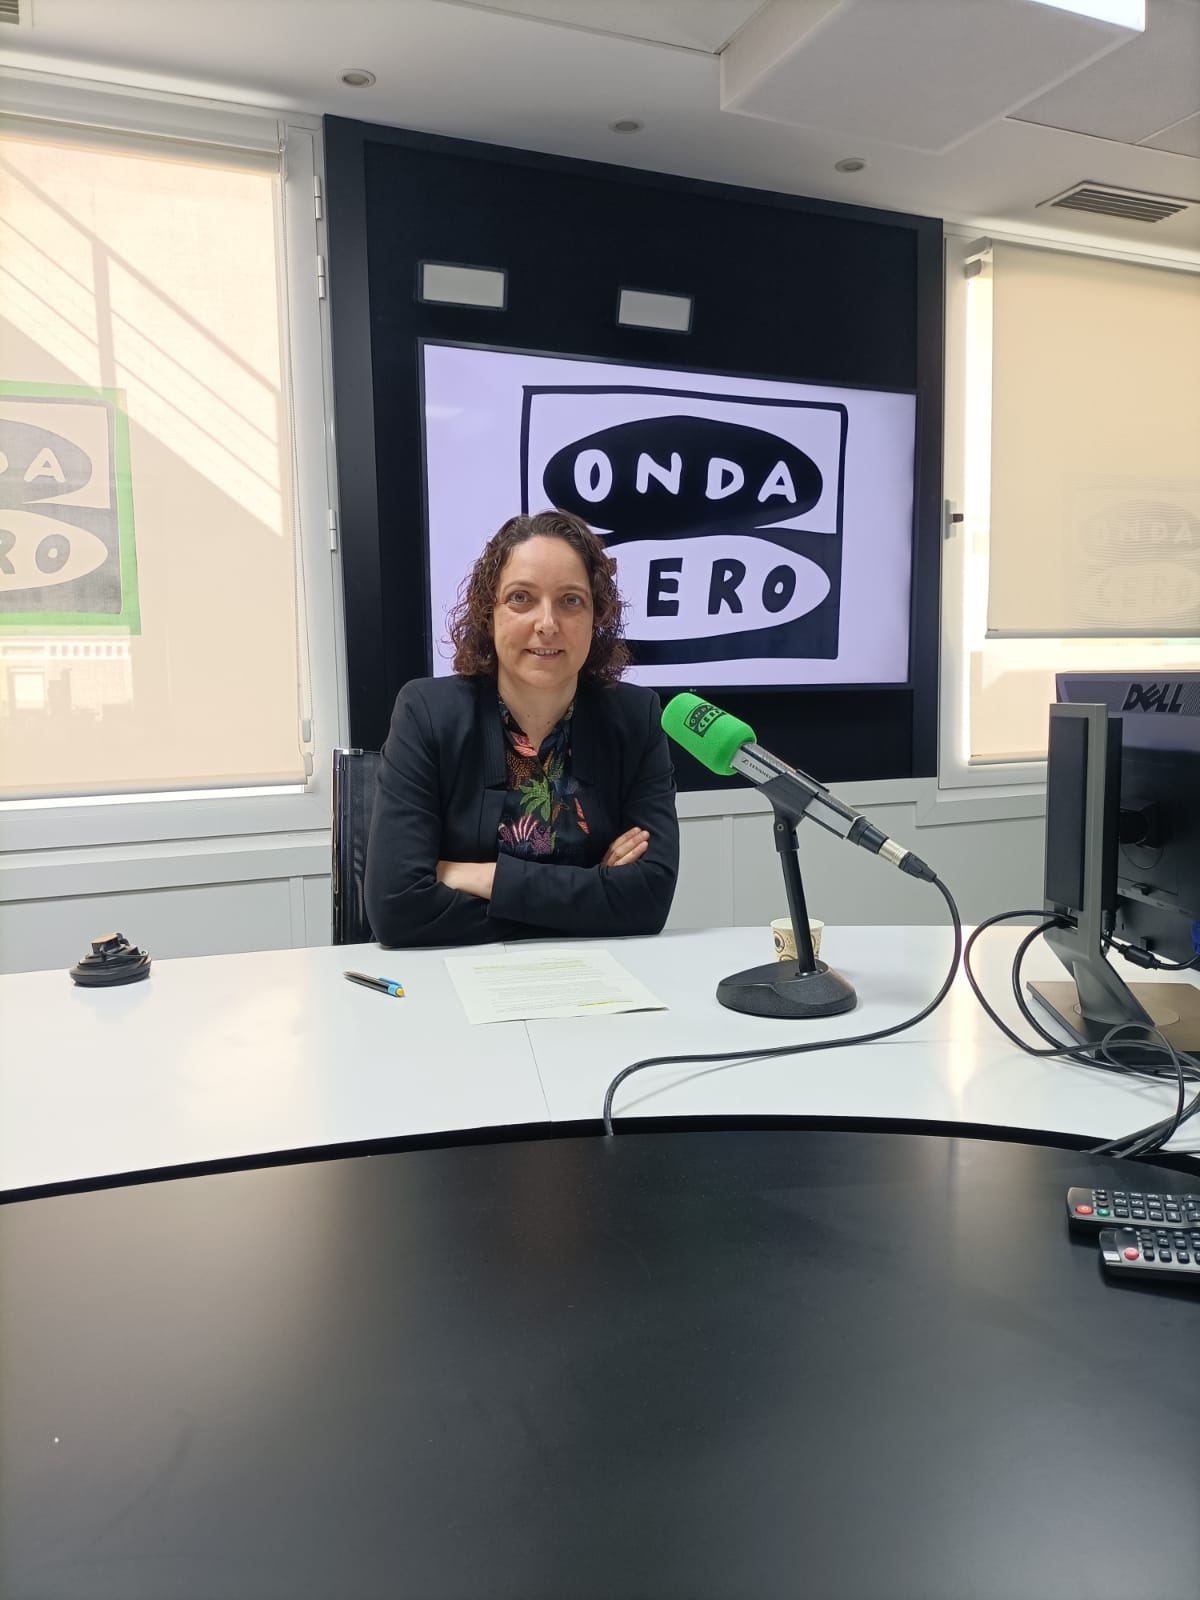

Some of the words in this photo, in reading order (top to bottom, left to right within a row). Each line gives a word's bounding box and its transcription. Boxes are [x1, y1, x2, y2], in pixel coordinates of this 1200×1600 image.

[573, 449, 797, 503] ONDA
[646, 556, 797, 617] ERO
[1122, 683, 1183, 713] DELL
